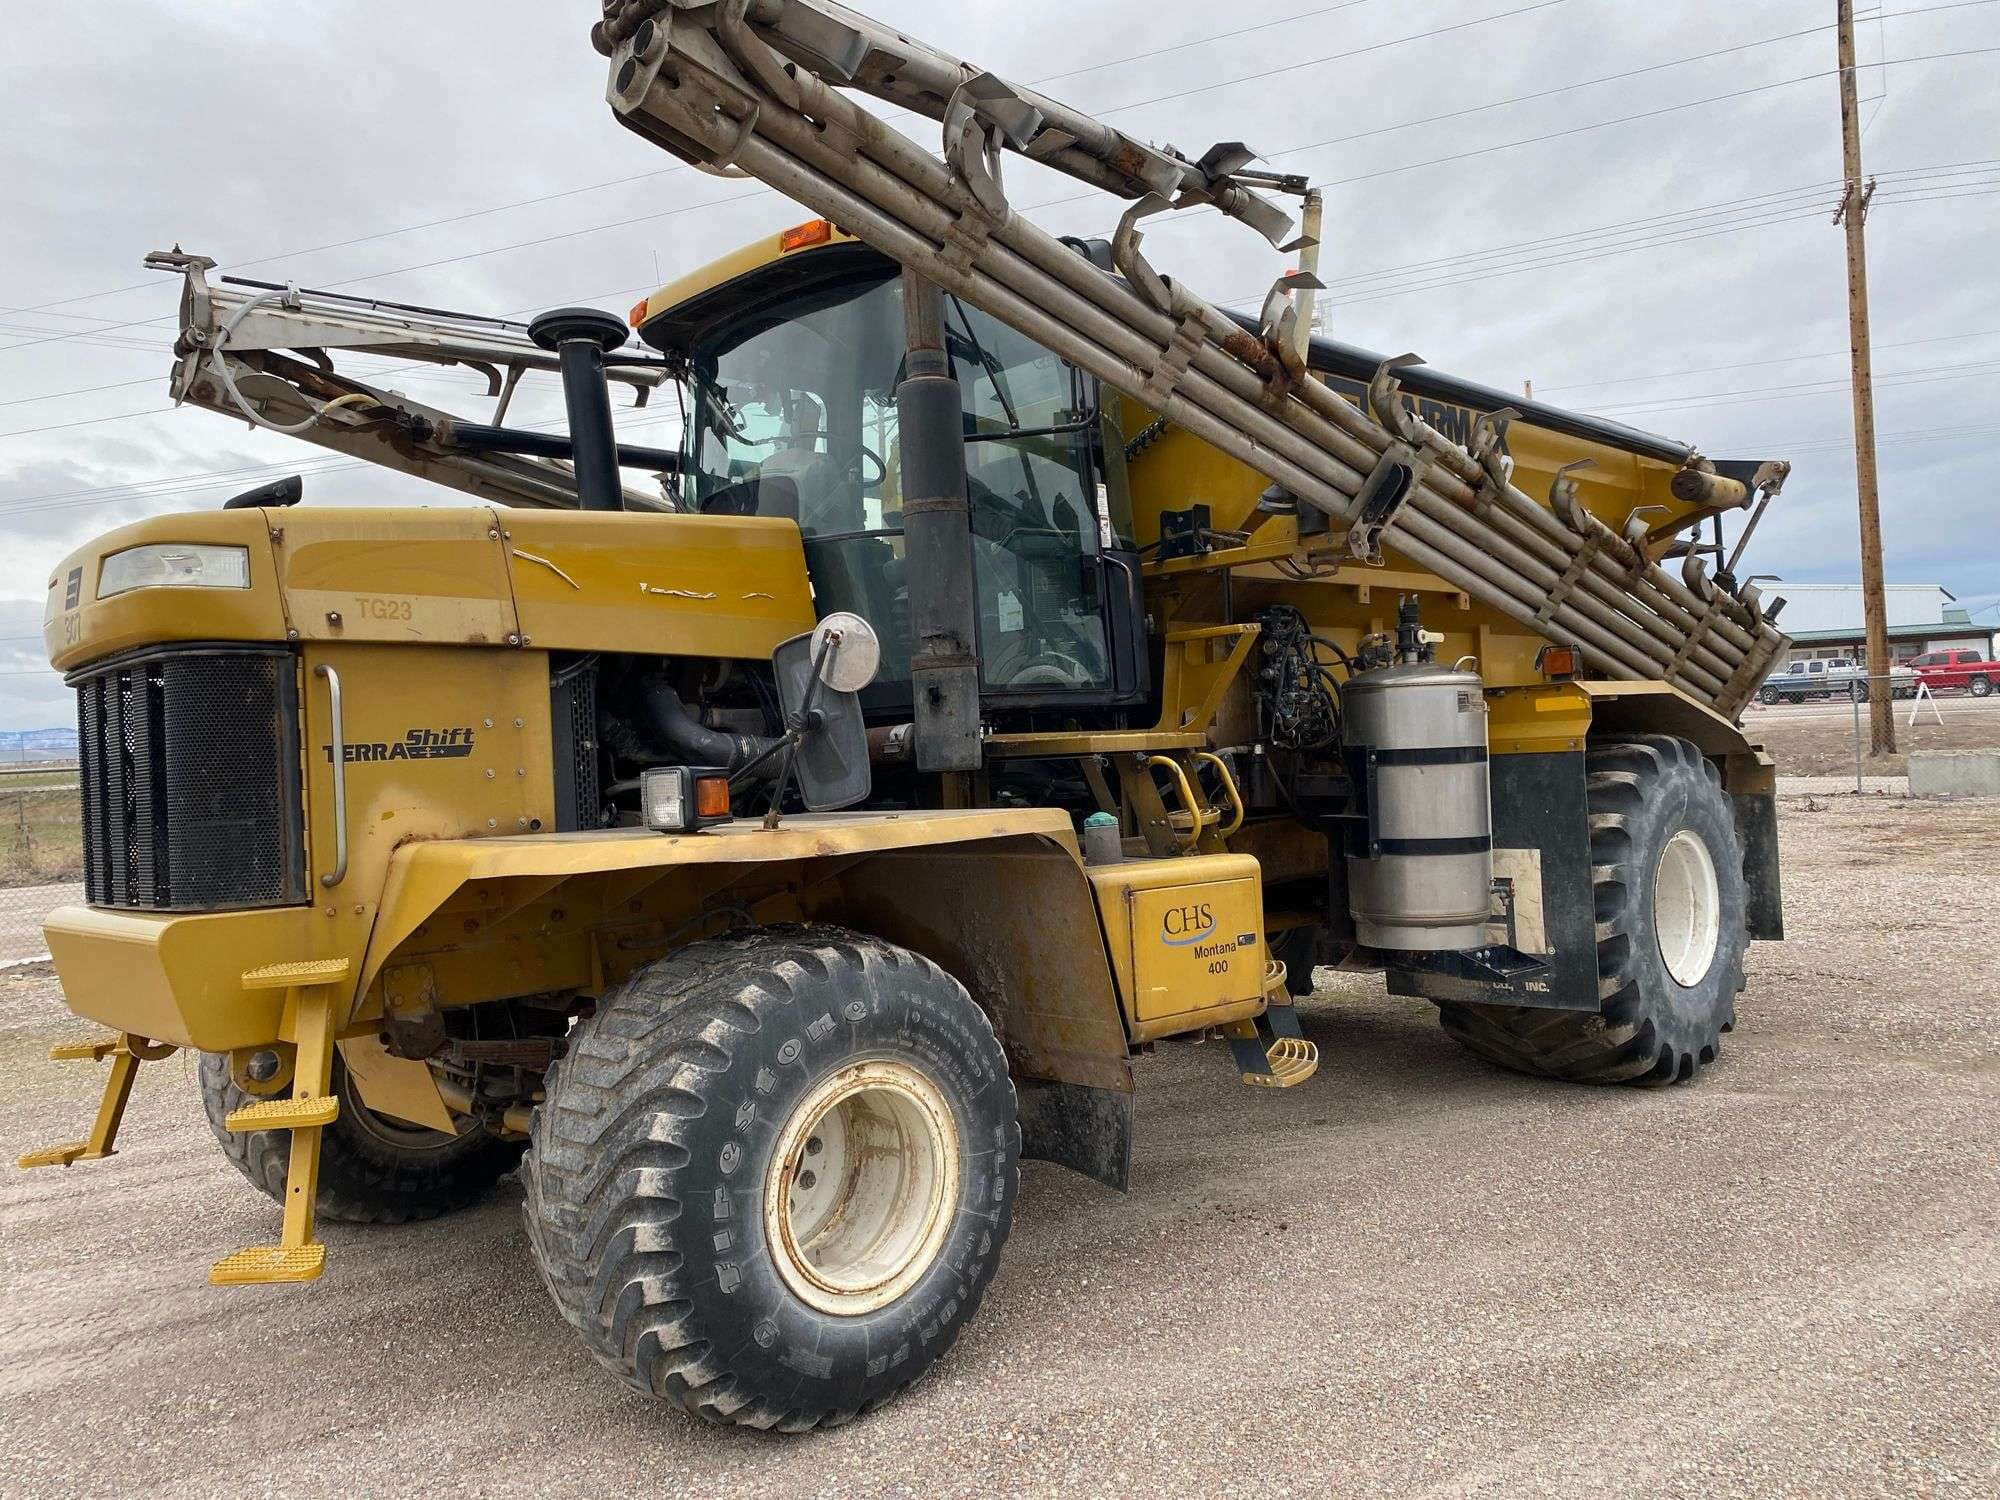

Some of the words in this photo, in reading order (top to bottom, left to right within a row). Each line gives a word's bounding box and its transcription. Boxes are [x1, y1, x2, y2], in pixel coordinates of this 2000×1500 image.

[355, 597, 412, 620] TG23
[322, 743, 409, 763] TERRA
[406, 727, 475, 746] Shift
[1163, 903, 1213, 935] CHS
[1194, 942, 1237, 960] Montana
[1208, 960, 1228, 975] 400
[1524, 980, 1550, 992] INC.
